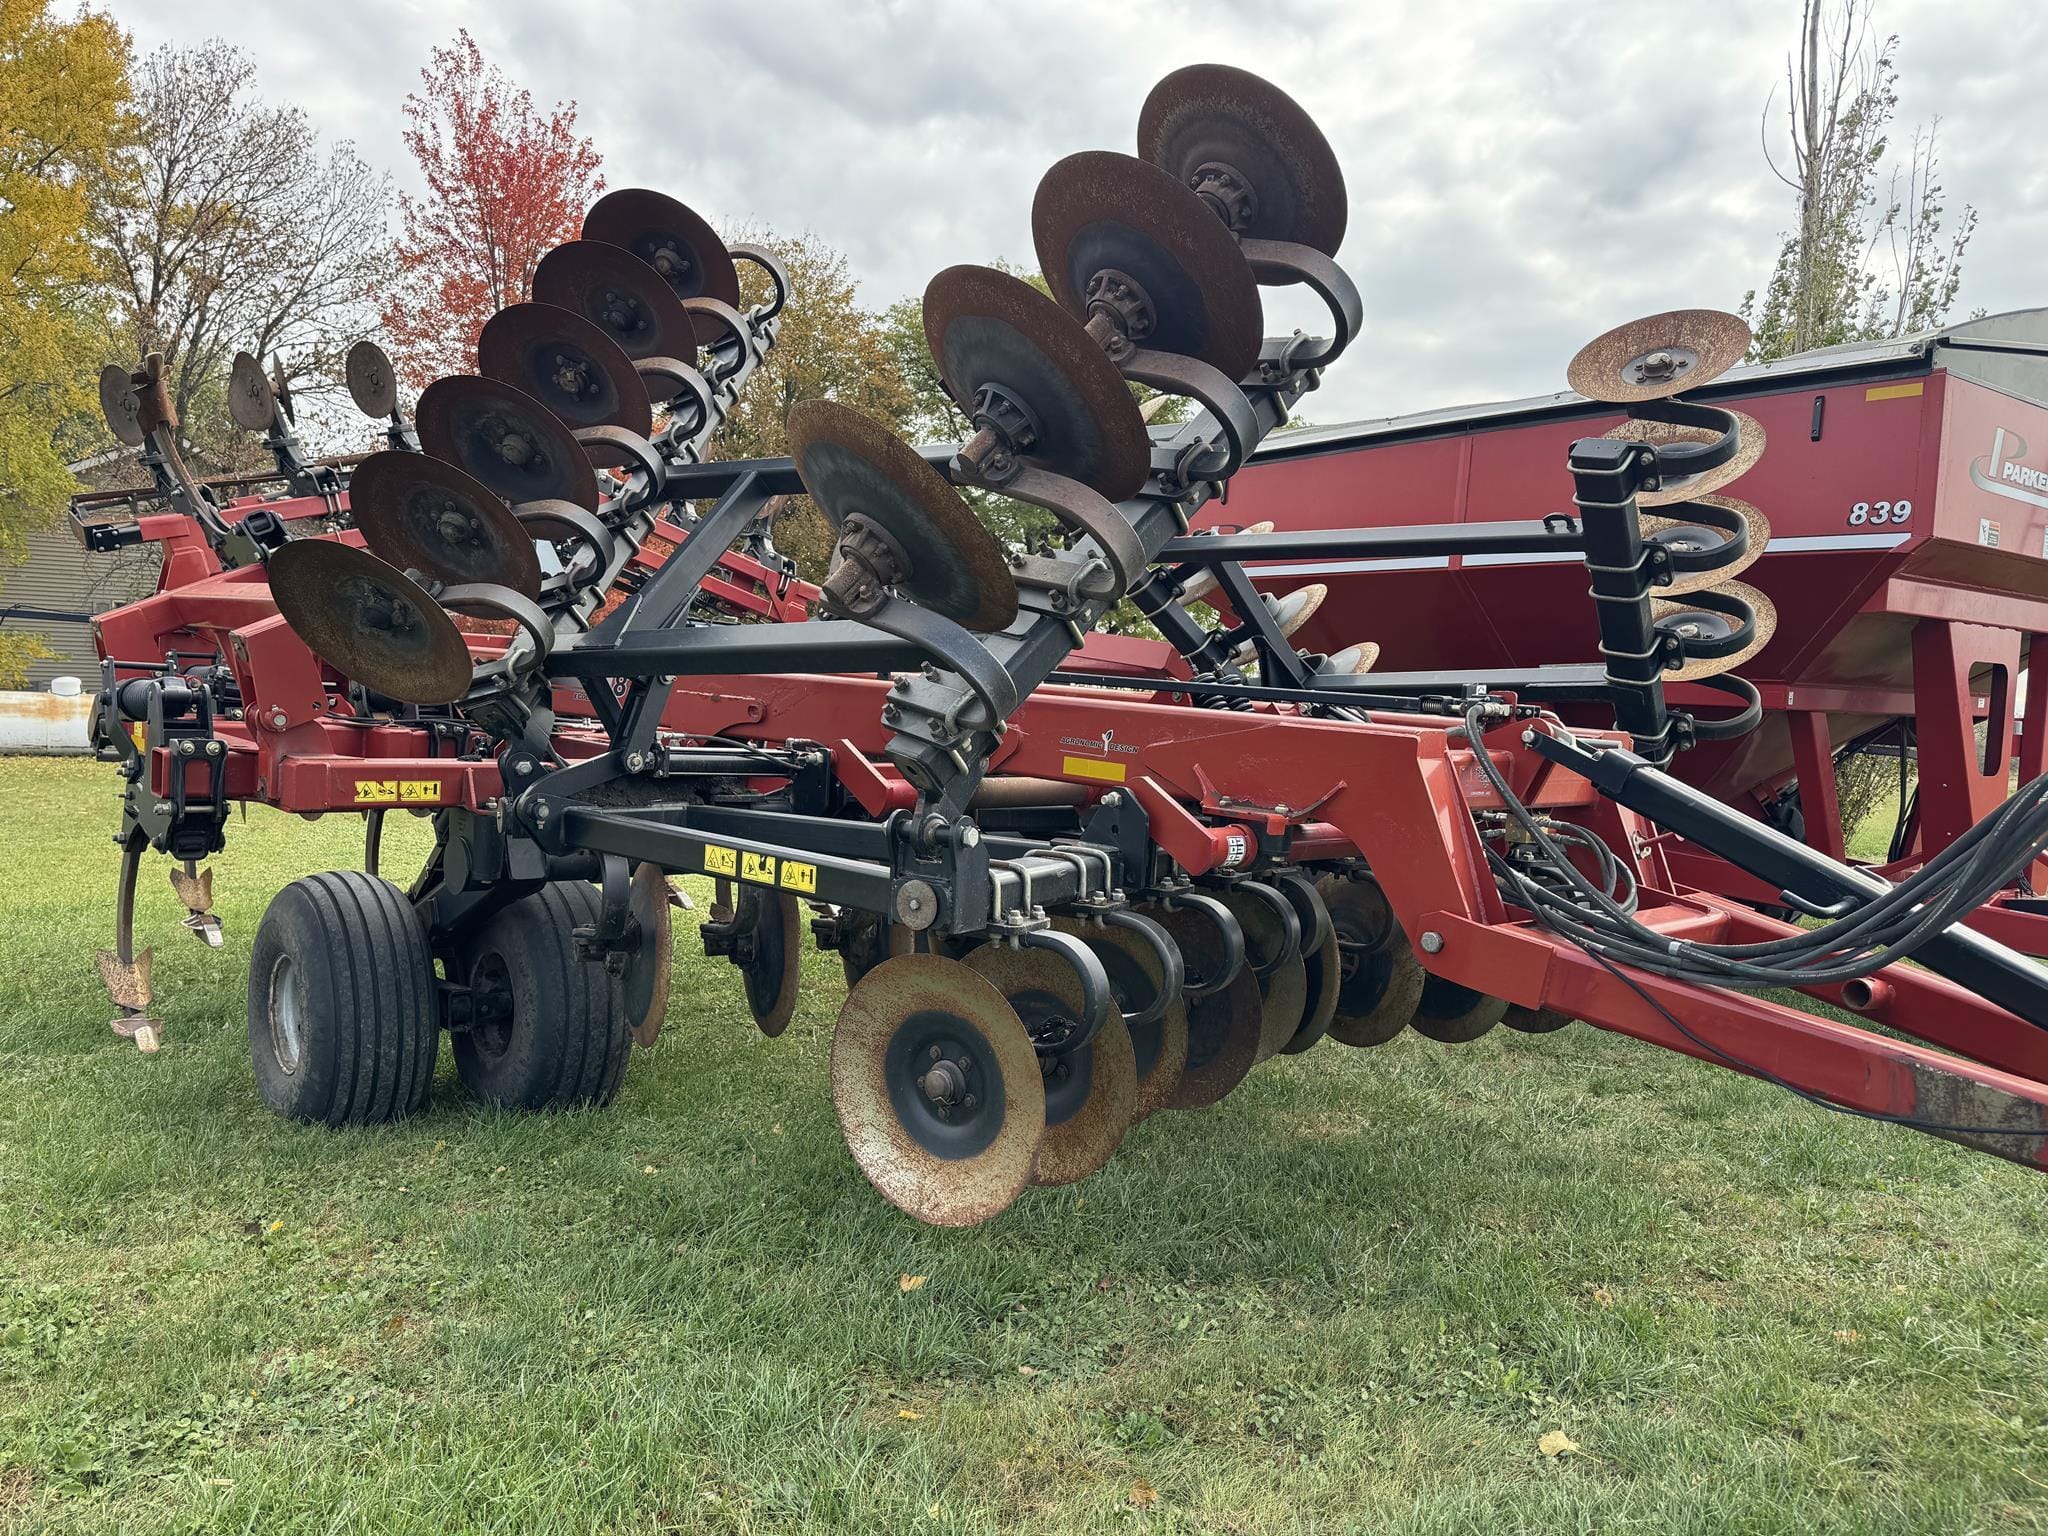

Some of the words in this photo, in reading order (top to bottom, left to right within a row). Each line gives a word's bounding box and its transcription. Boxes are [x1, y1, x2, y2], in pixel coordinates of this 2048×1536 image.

[1848, 499, 1912, 527] 839
[1060, 736, 1103, 750] AGRONOMIC
[1108, 742, 1140, 754] DESIGN
